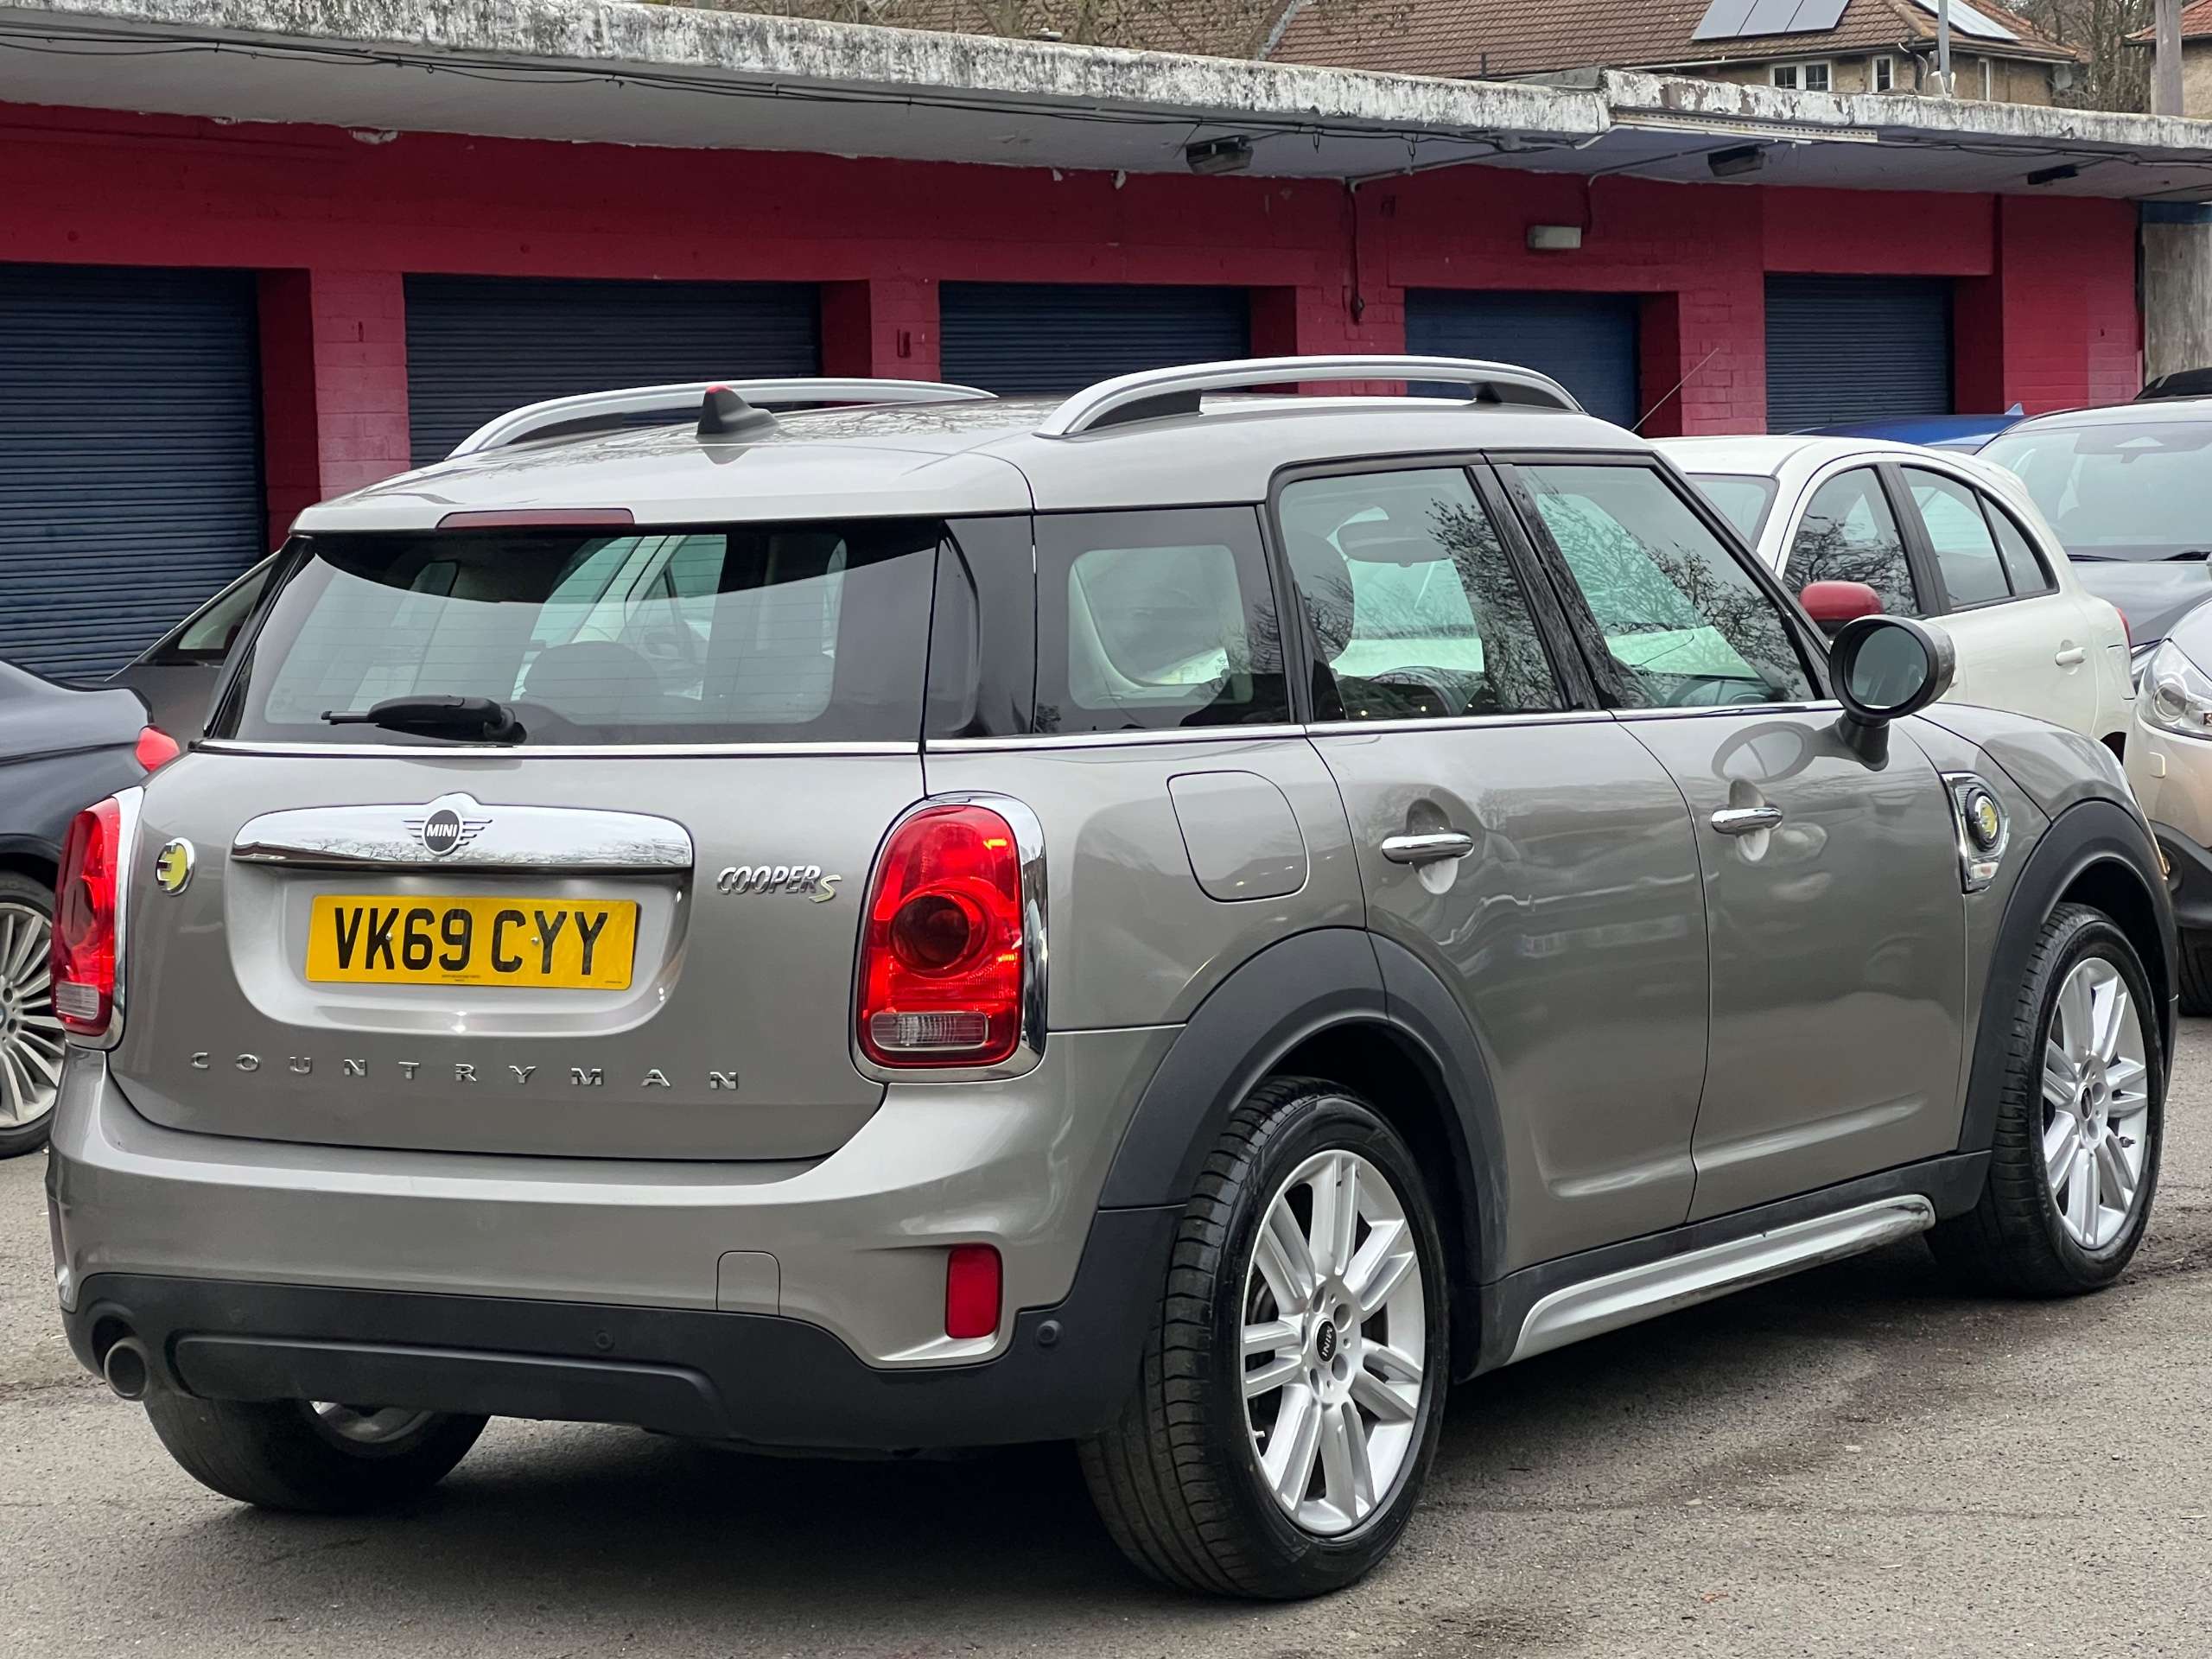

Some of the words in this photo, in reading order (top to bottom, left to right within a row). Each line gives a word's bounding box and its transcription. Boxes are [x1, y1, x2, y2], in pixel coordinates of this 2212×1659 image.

[427, 823, 458, 837] MINI
[334, 907, 473, 972] VK69
[491, 910, 608, 976] CYY
[190, 1052, 738, 1090] COUNTRYMAN
[1322, 1325, 1333, 1357] MINI
